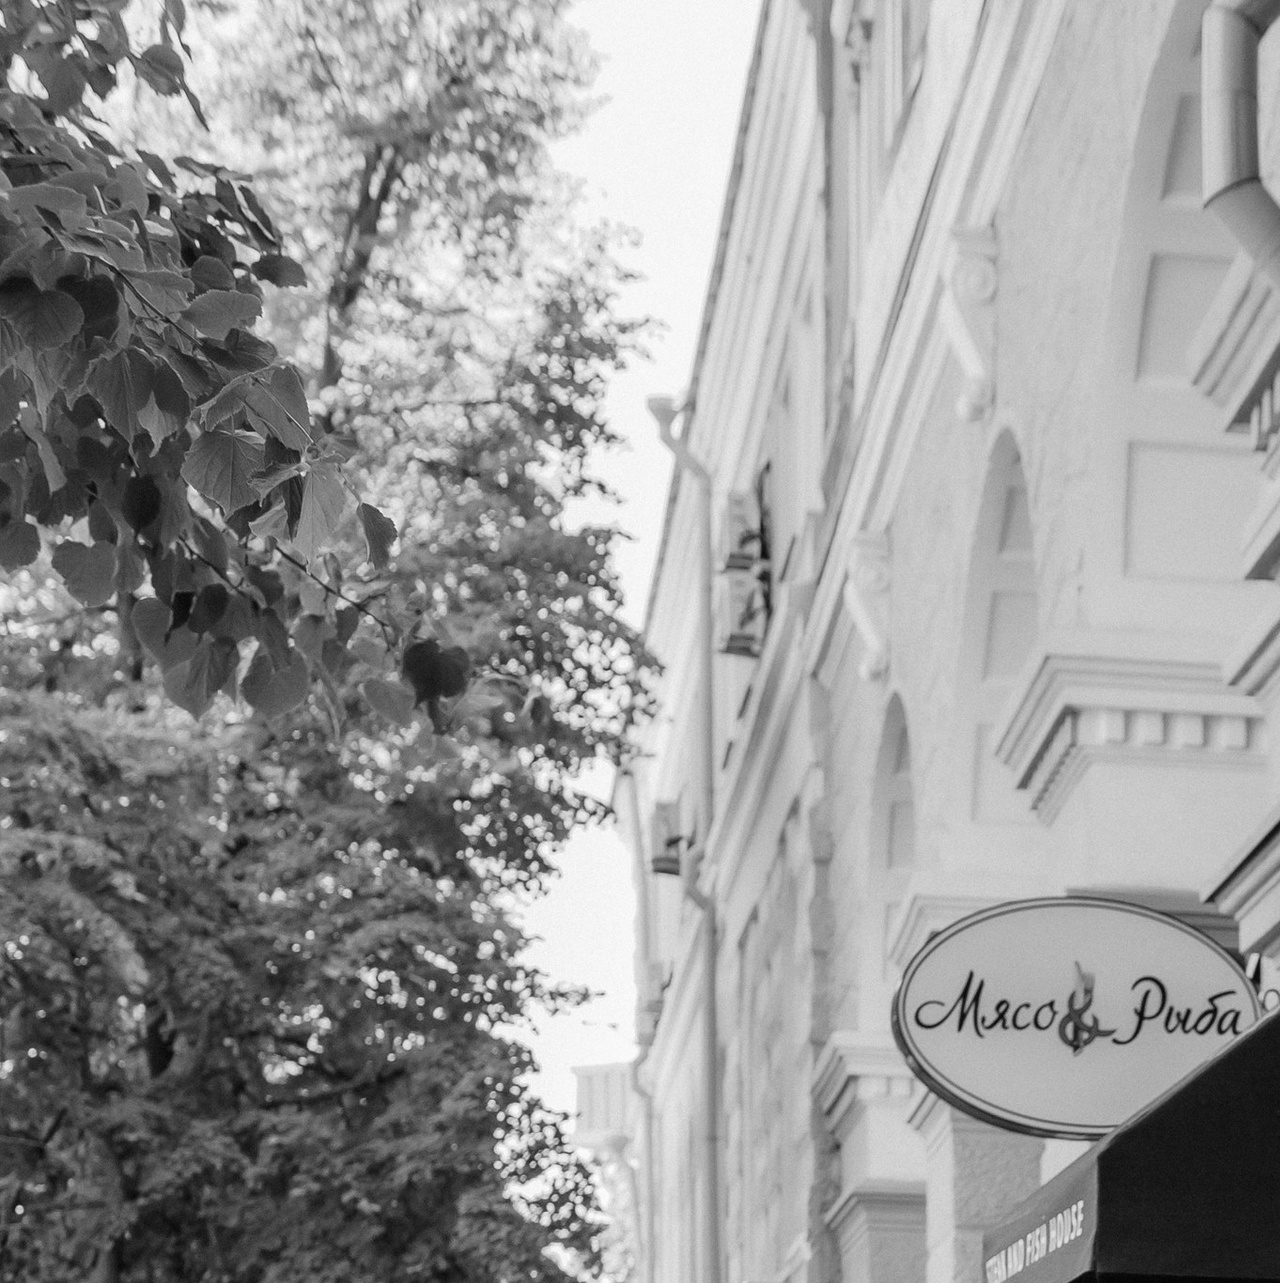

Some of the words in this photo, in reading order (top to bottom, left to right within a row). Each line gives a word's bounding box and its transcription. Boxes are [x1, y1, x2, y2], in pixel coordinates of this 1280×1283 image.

[915, 970, 1058, 1038] Мясо
[1112, 976, 1242, 1044] Рыба
[1025, 1223, 1047, 1267] FISH
[1048, 1200, 1084, 1253] HOUSE
